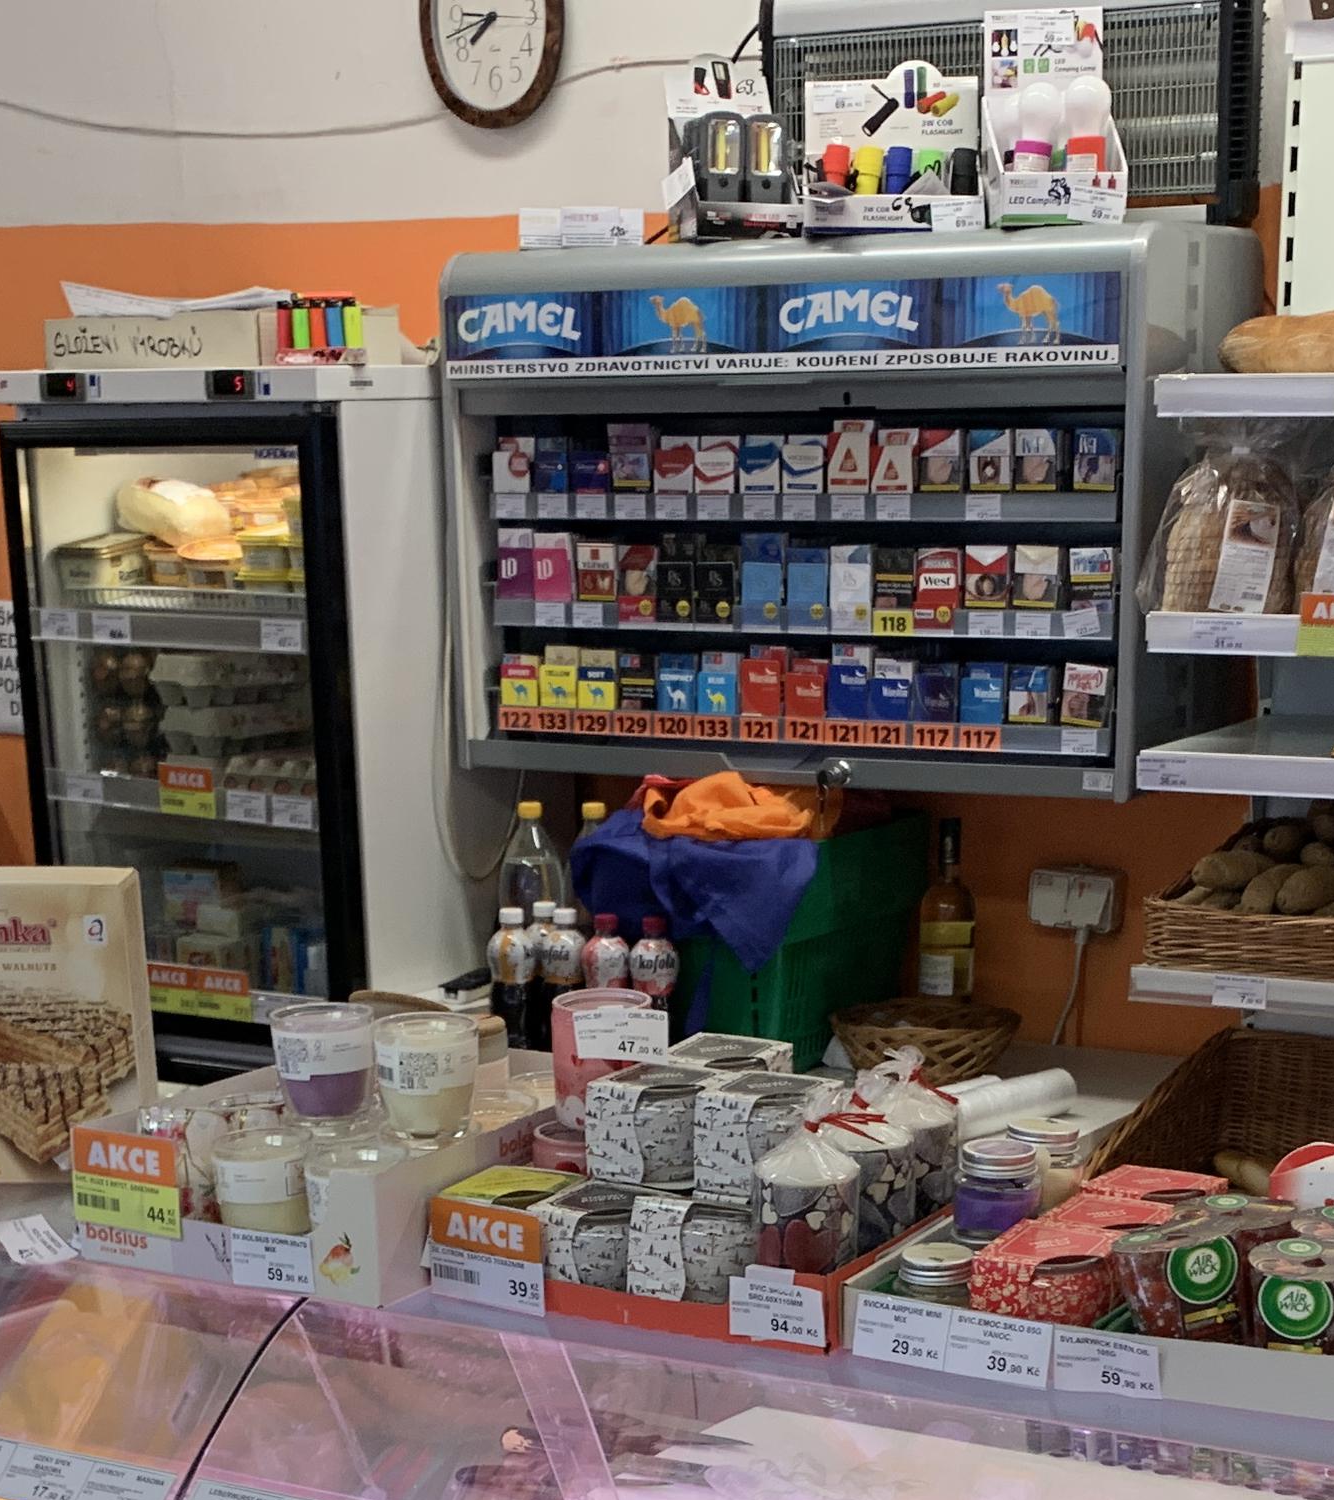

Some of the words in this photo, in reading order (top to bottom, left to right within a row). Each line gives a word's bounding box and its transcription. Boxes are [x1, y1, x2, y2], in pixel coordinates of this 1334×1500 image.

[779, 288, 920, 334] CAMEL
[457, 301, 581, 344] CAMEL
[449, 360, 569, 377] MINISTERSTVO
[575, 355, 710, 373] ZDRAVOTNICTVÍ
[716, 354, 790, 370] VARUJE:
[796, 350, 880, 369] KOUŘENÍ
[886, 348, 998, 366] ZPŮSOBUJE
[1004, 347, 1118, 364] RAKOVINU.
[923, 574, 952, 588] West
[880, 616, 907, 633] 118
[501, 711, 532, 729] 122
[538, 712, 567, 729] 133
[577, 714, 607, 732] 129
[617, 715, 648, 733] 129
[657, 716, 688, 734] 120
[697, 719, 729, 737] 133
[744, 721, 775, 739] 121
[828, 724, 859, 743] 121
[916, 728, 949, 747] 117
[962, 731, 997, 749] 117
[88, 1140, 161, 1177] AKCE
[147, 1206, 165, 1223] 44
[447, 1210, 525, 1251] AKCE
[1188, 1261, 1221, 1278] WICK
[1190, 1253, 1214, 1270] AIR
[508, 1279, 528, 1299] 39
[1282, 1290, 1308, 1306] AIR
[1278, 1297, 1312, 1314] WICK
